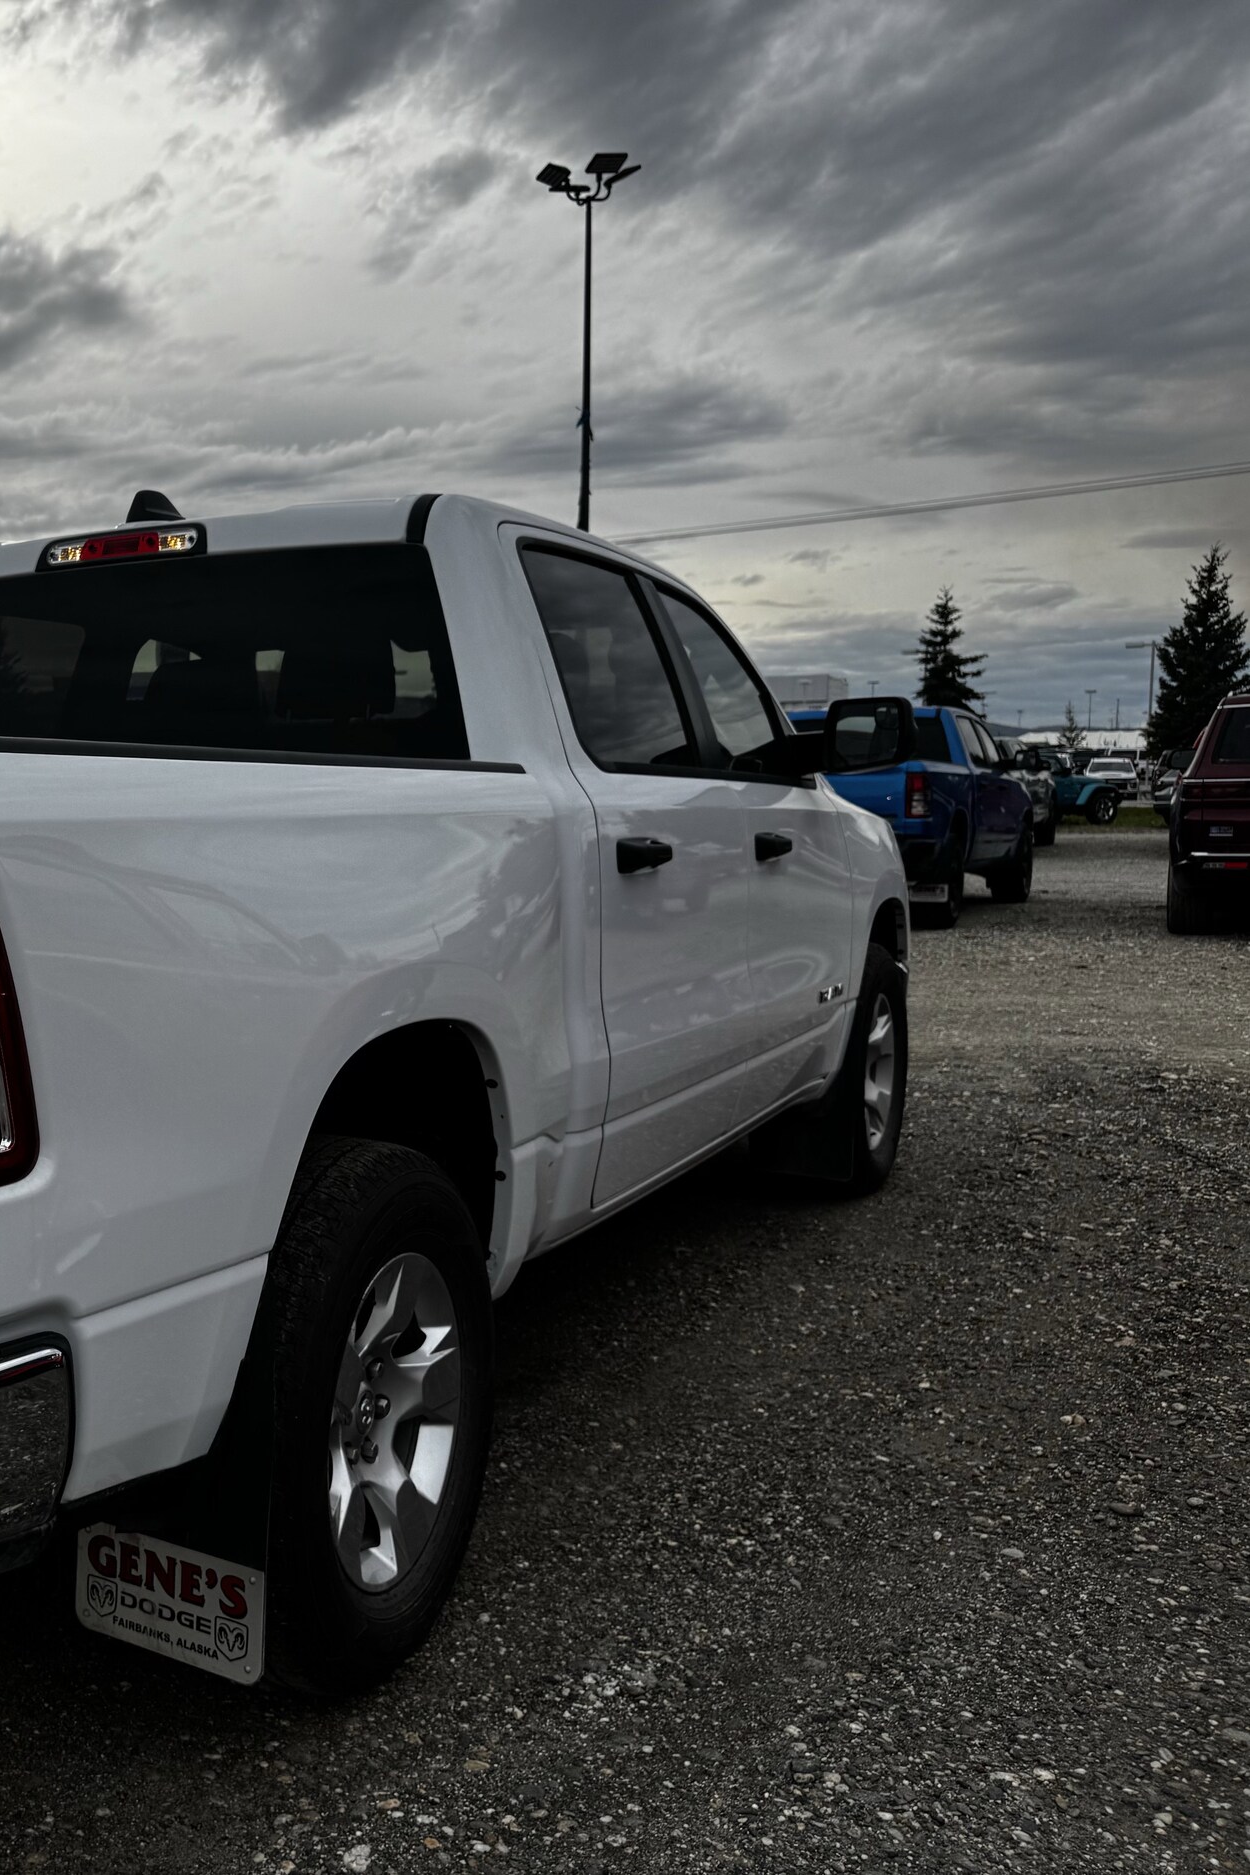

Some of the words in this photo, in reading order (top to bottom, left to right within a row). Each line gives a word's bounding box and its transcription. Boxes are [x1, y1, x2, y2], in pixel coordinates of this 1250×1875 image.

[87, 1534, 248, 1620] GENE'S
[120, 1591, 212, 1635] DODGE
[112, 1615, 174, 1646] FAIRBANKS,
[176, 1637, 219, 1660] ALASKA
